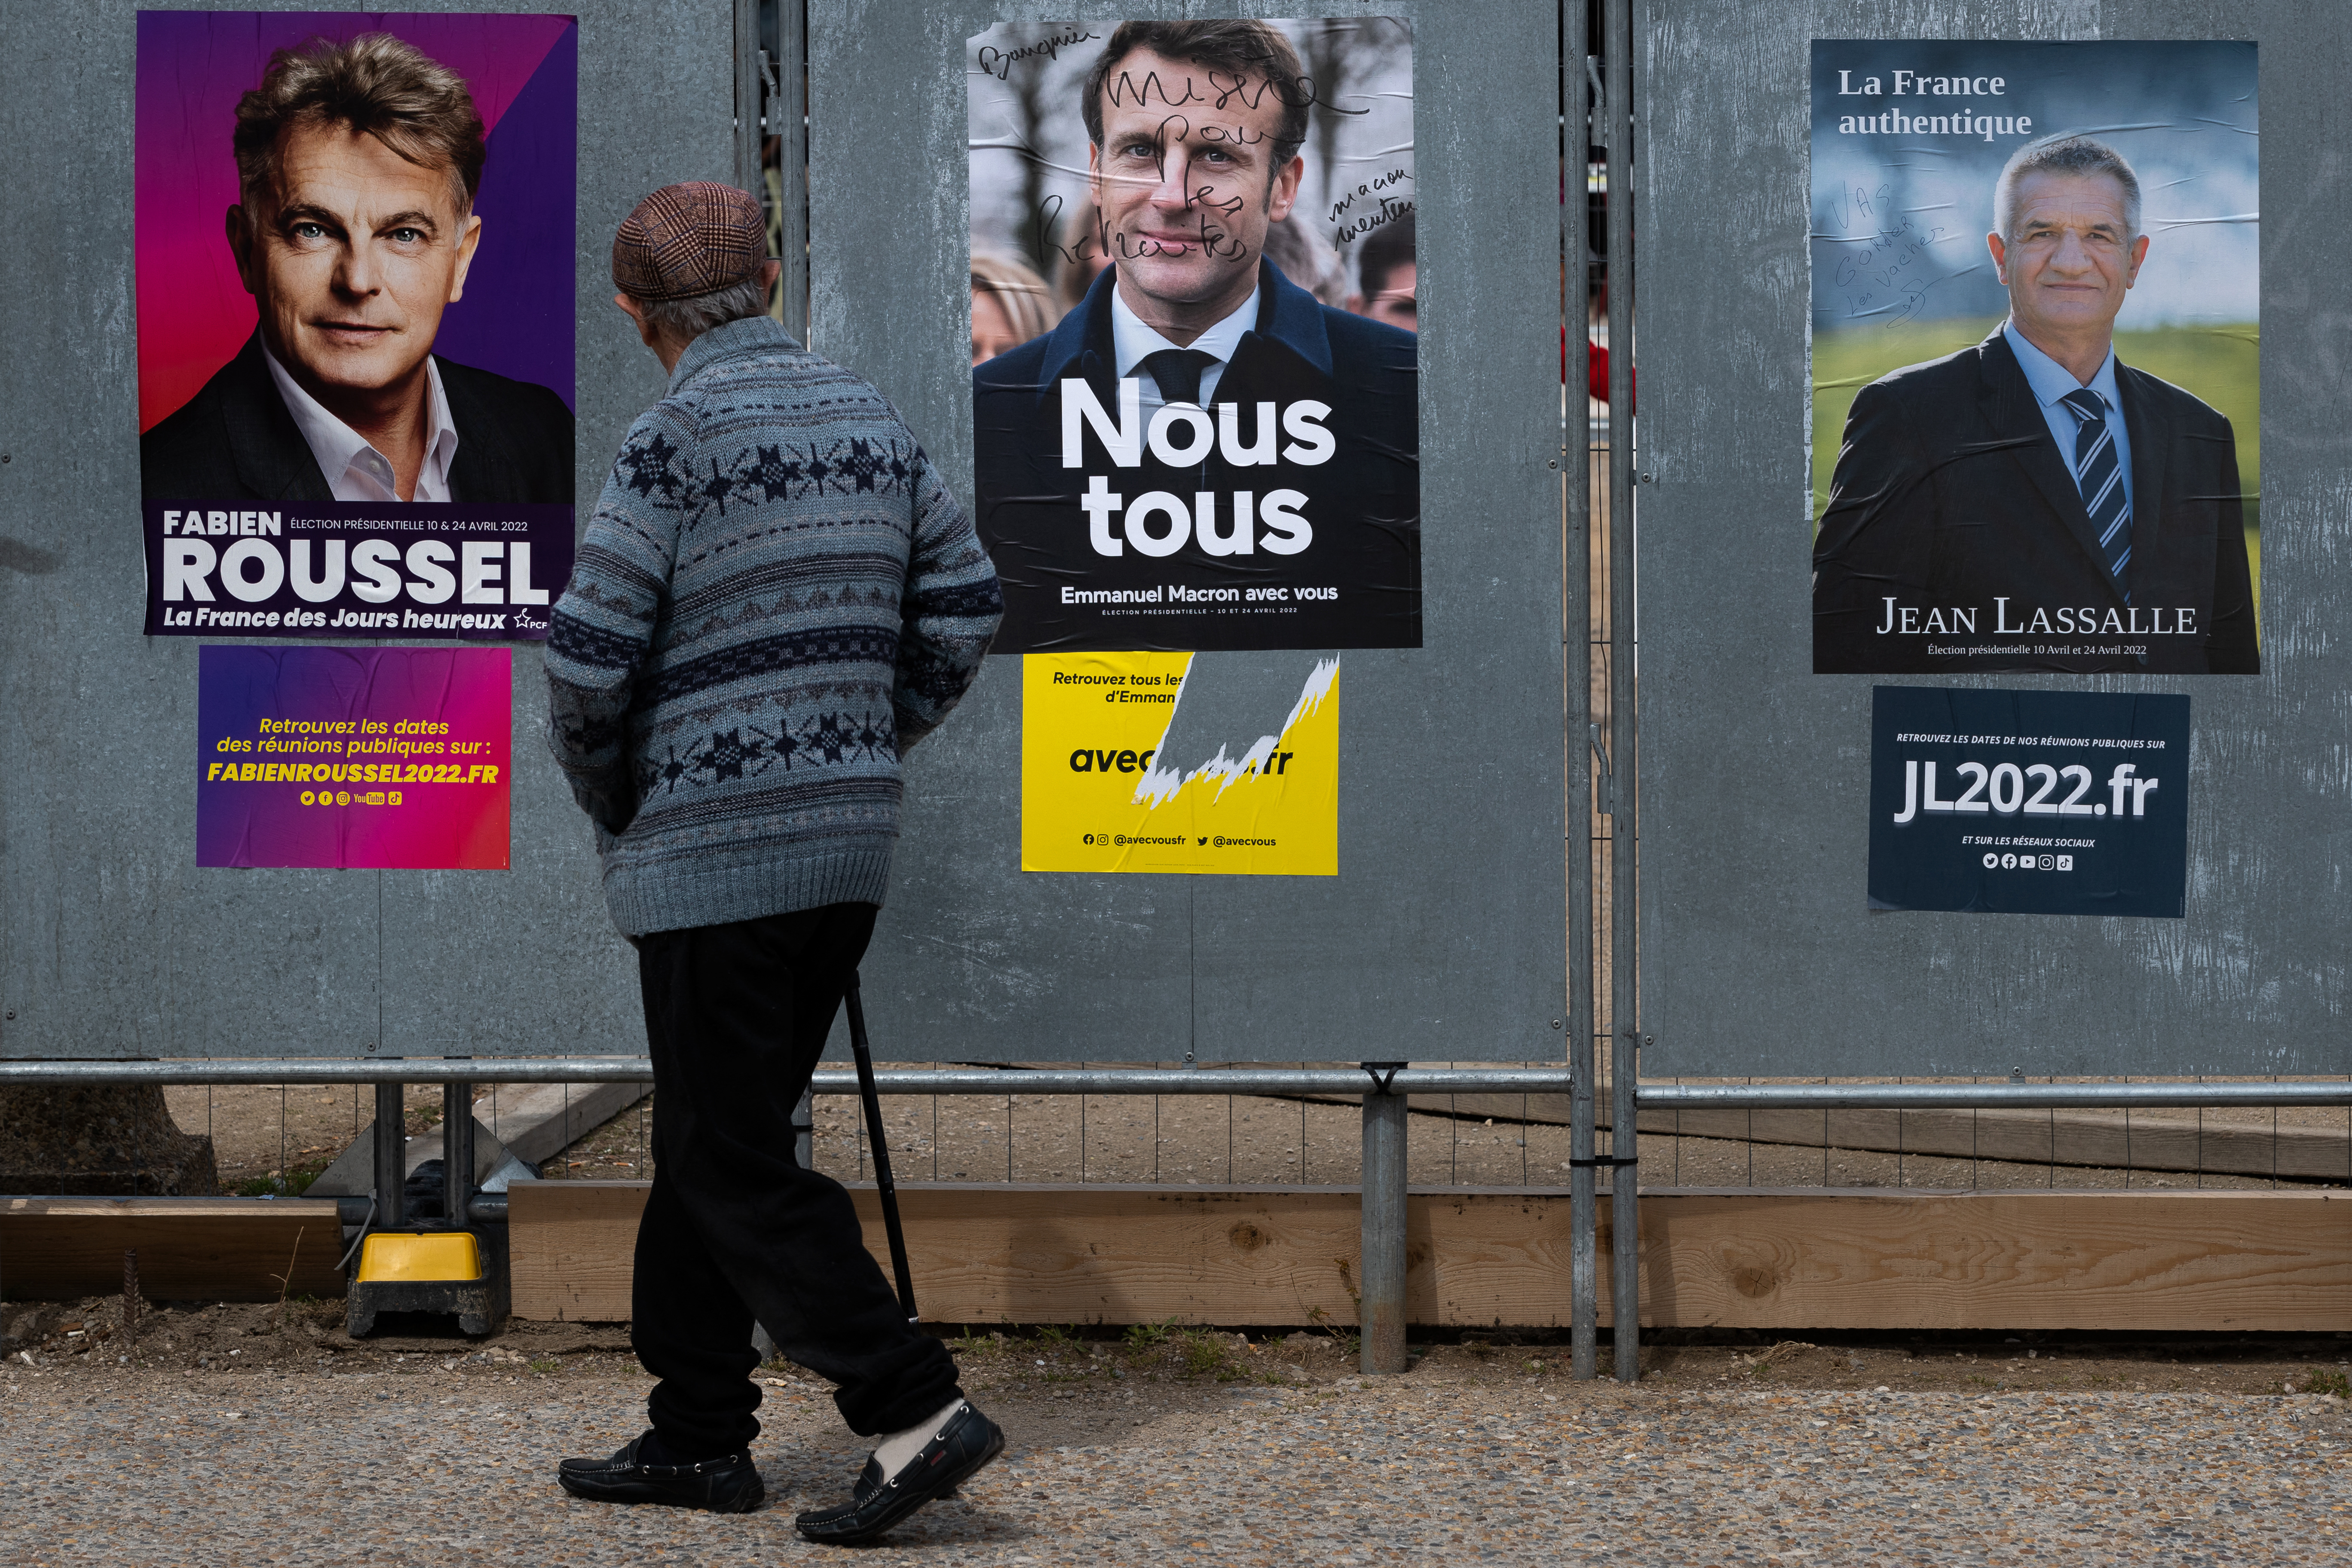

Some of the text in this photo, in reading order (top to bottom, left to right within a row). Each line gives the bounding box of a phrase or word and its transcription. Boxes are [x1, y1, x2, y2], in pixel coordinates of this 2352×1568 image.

[1838, 70, 2005, 95] La France
[1839, 108, 2031, 142] authentique
[1061, 377, 1336, 468] Nous
[164, 511, 281, 536] FABIEN
[291, 517, 527, 531] ÉLECTION PRÉSIDENTIELLE 10 & 24 AVRIL 2022
[1081, 476, 1313, 557] tous
[163, 538, 549, 605] ROUSSEL
[1062, 585, 1338, 603] Emmanuel Macron avec vous
[163, 607, 506, 629] La France des Jours heureux
[530, 621, 548, 629] PCF
[1877, 597, 2197, 634] JEAN LASSALLE
[1928, 643, 1966, 654] Élection
[1969, 645, 2030, 656] présidentielle
[2034, 645, 2045, 654] 10
[2047, 645, 2070, 654] Avril
[2084, 646, 2095, 654] 24
[2098, 645, 2120, 654] Avril
[2124, 646, 2147, 654] 2022
[1053, 672, 1126, 685] Retrouvez
[1130, 674, 1161, 685] tous
[259, 718, 449, 735] Retrouvez les dates
[217, 737, 252, 752] des
[257, 736, 342, 753] réunions
[346, 737, 444, 758] publiques
[450, 742, 482, 754] sur
[1897, 733, 2165, 749] RETROUVEZ LES DATES DE NOS RÉUNIONS PUBLIQUES SUR
[207, 763, 499, 783] FABIENROUSSEL2022.FR
[354, 792, 385, 805] YouTube
[1894, 760, 2159, 823] JL2022.fr
[1114, 834, 1276, 848] @avecvousfr @avecvous
[1975, 836, 1993, 845] SUR
[1995, 837, 2011, 845] LES
[2012, 835, 2053, 846] RÉSEAUX
[2055, 839, 2095, 847] SOCIAUX
